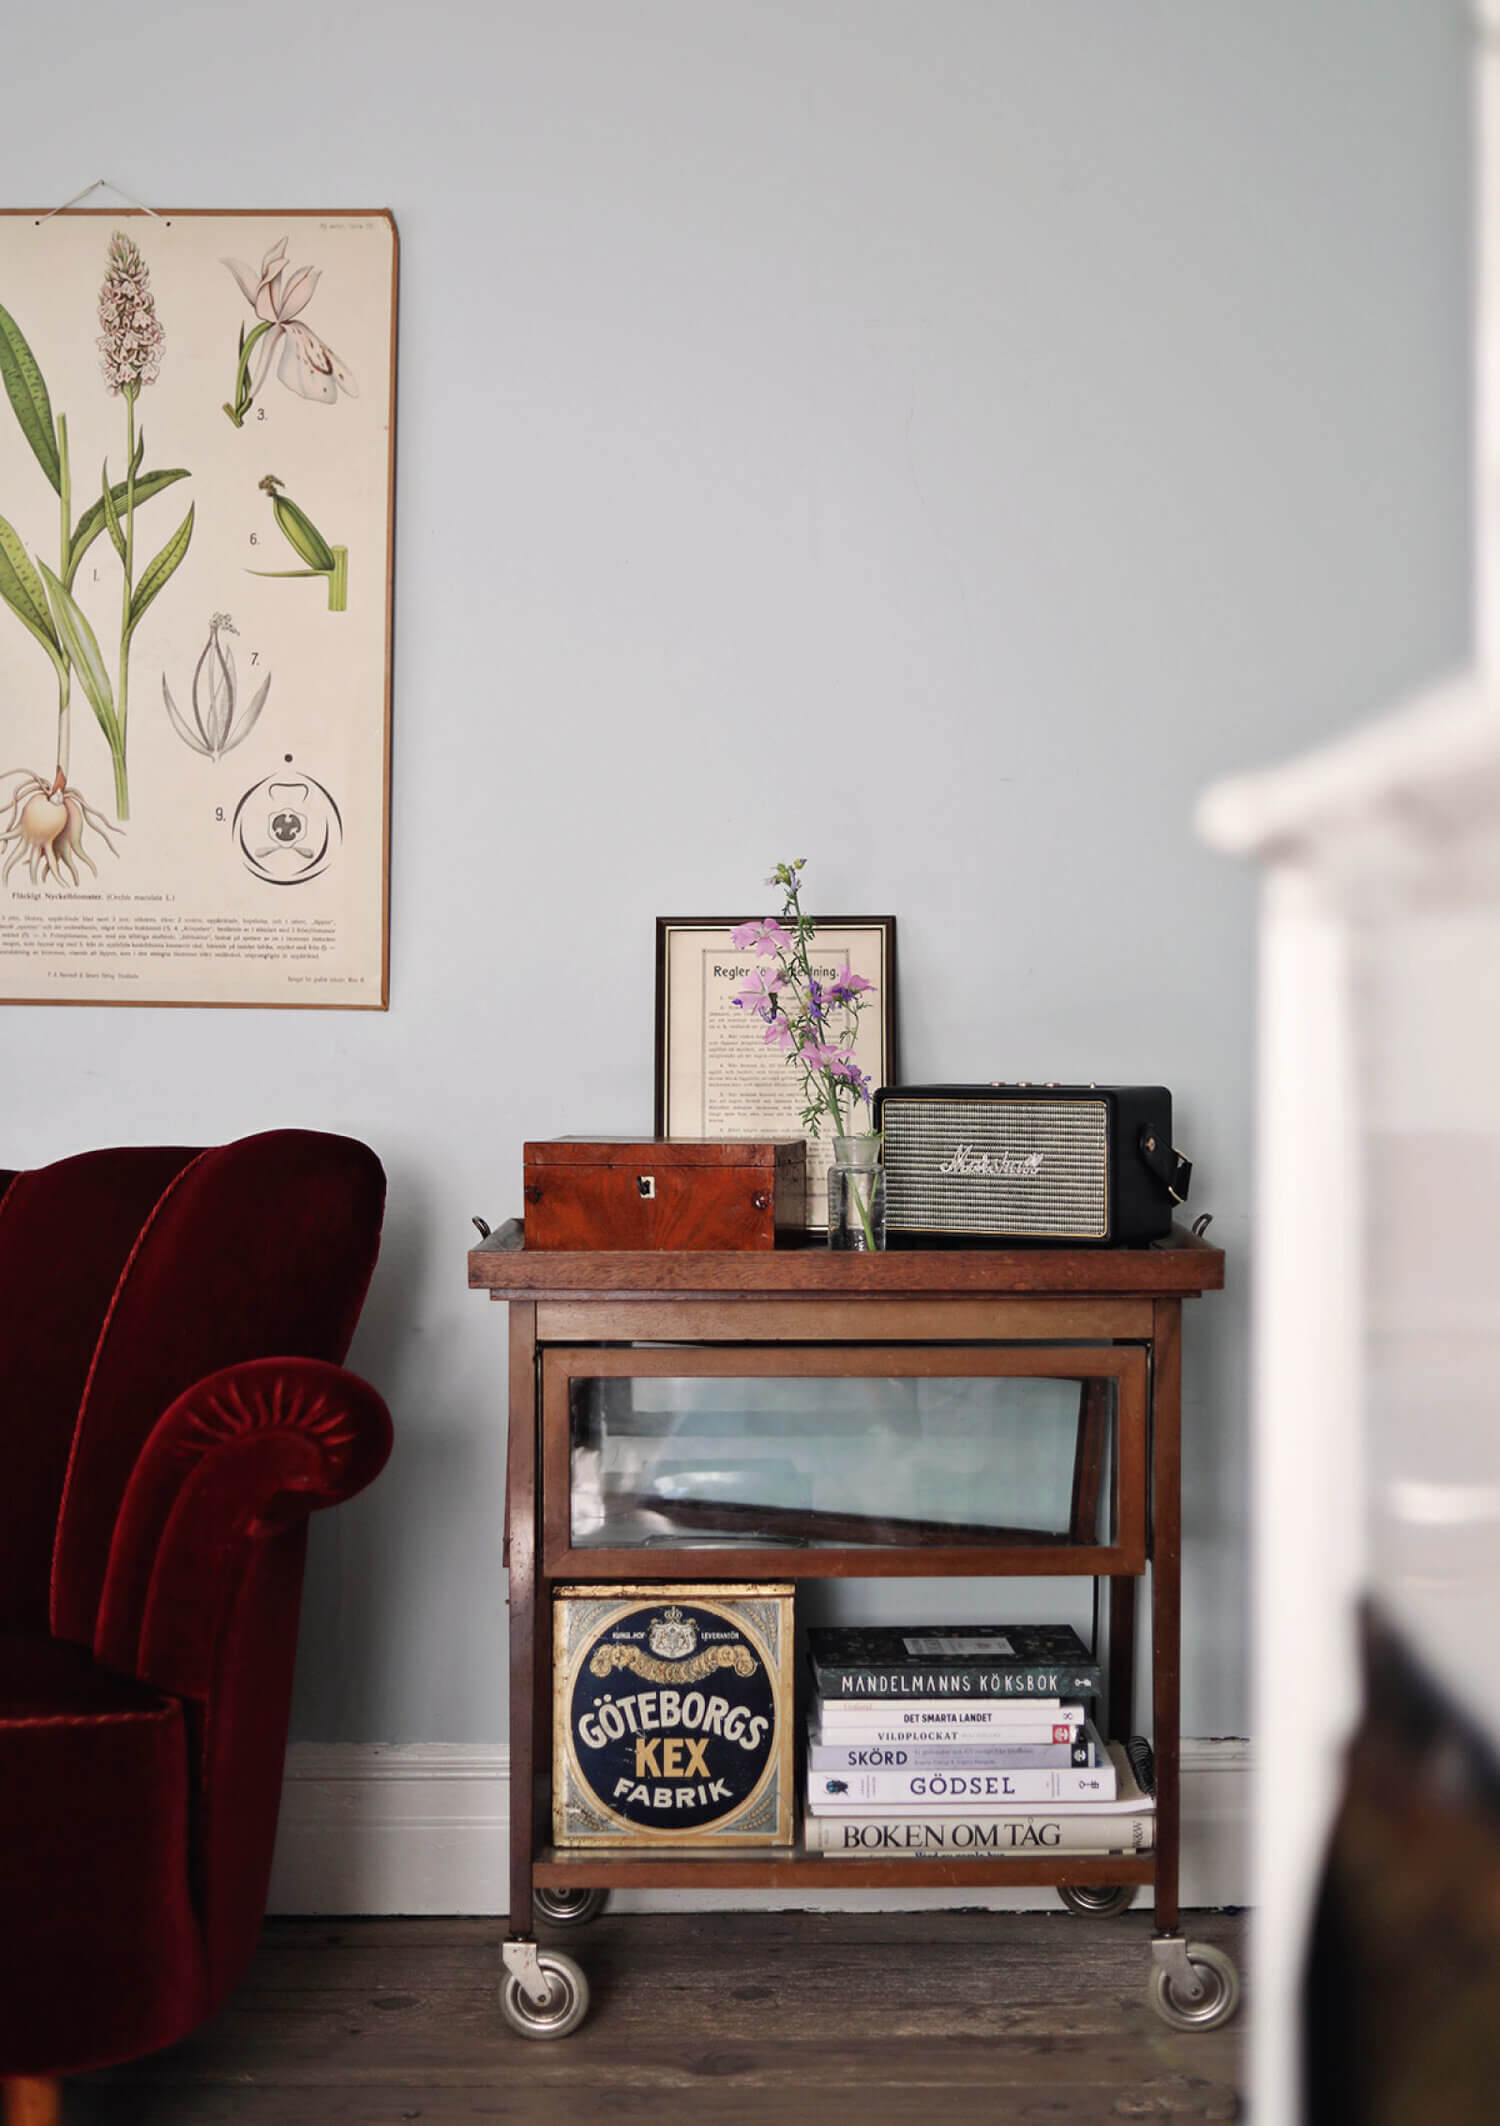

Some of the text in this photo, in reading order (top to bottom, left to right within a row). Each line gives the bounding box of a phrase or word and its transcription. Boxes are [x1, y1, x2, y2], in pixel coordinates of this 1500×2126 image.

[256, 407, 268, 421] 3.
[249, 532, 260, 546] 6.
[251, 652, 260, 665] 7.
[215, 806, 226, 822] 9.
[713, 965, 750, 980] Regler
[940, 1144, 1044, 1176] Marshall
[841, 1673, 1058, 1692] MANDELMANNS KÖKSBOK
[578, 1690, 769, 1750] GÖTEBORGS
[904, 1712, 992, 1723] DET SMARTA LANDET
[878, 1732, 959, 1741] VILDPLOCKAT
[635, 1737, 711, 1778] KEX
[848, 1748, 908, 1766] SKÖRD
[612, 1777, 733, 1808] FABRIK
[910, 1773, 1015, 1795] GÖDSEL
[843, 1824, 945, 1848] BOKEN
[951, 1824, 999, 1848] OM
[1004, 1816, 1062, 1847] TÅG
